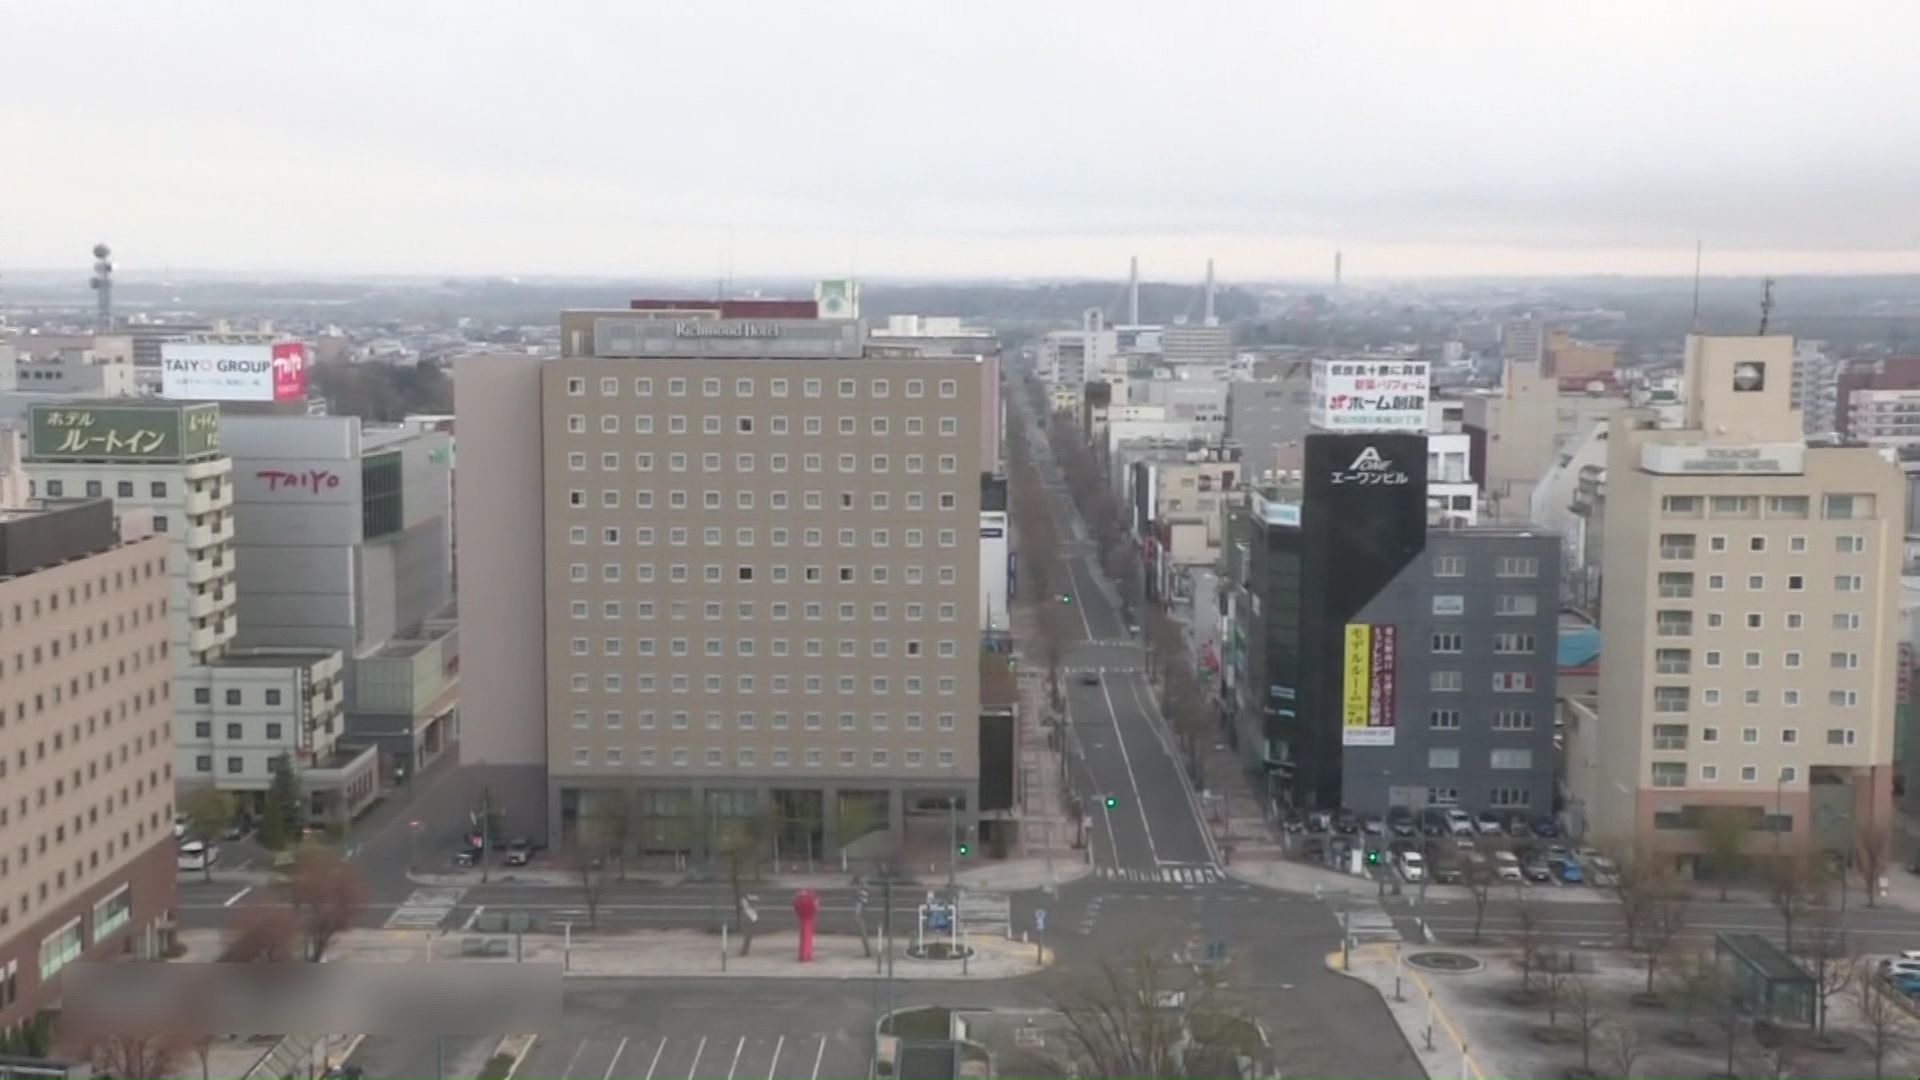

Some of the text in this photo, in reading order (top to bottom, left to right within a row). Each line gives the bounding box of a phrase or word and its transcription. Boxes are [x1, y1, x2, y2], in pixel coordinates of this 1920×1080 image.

[676, 322, 779, 337] Richmond Hotel
[164, 359, 271, 373] TAIYO GROUP
[1347, 395, 1425, 411] ホーム創建
[47, 411, 96, 427] ホテル
[57, 428, 166, 454] ルートイン
[255, 469, 340, 495] TAIYO
[1331, 472, 1409, 485] エーワンビル
